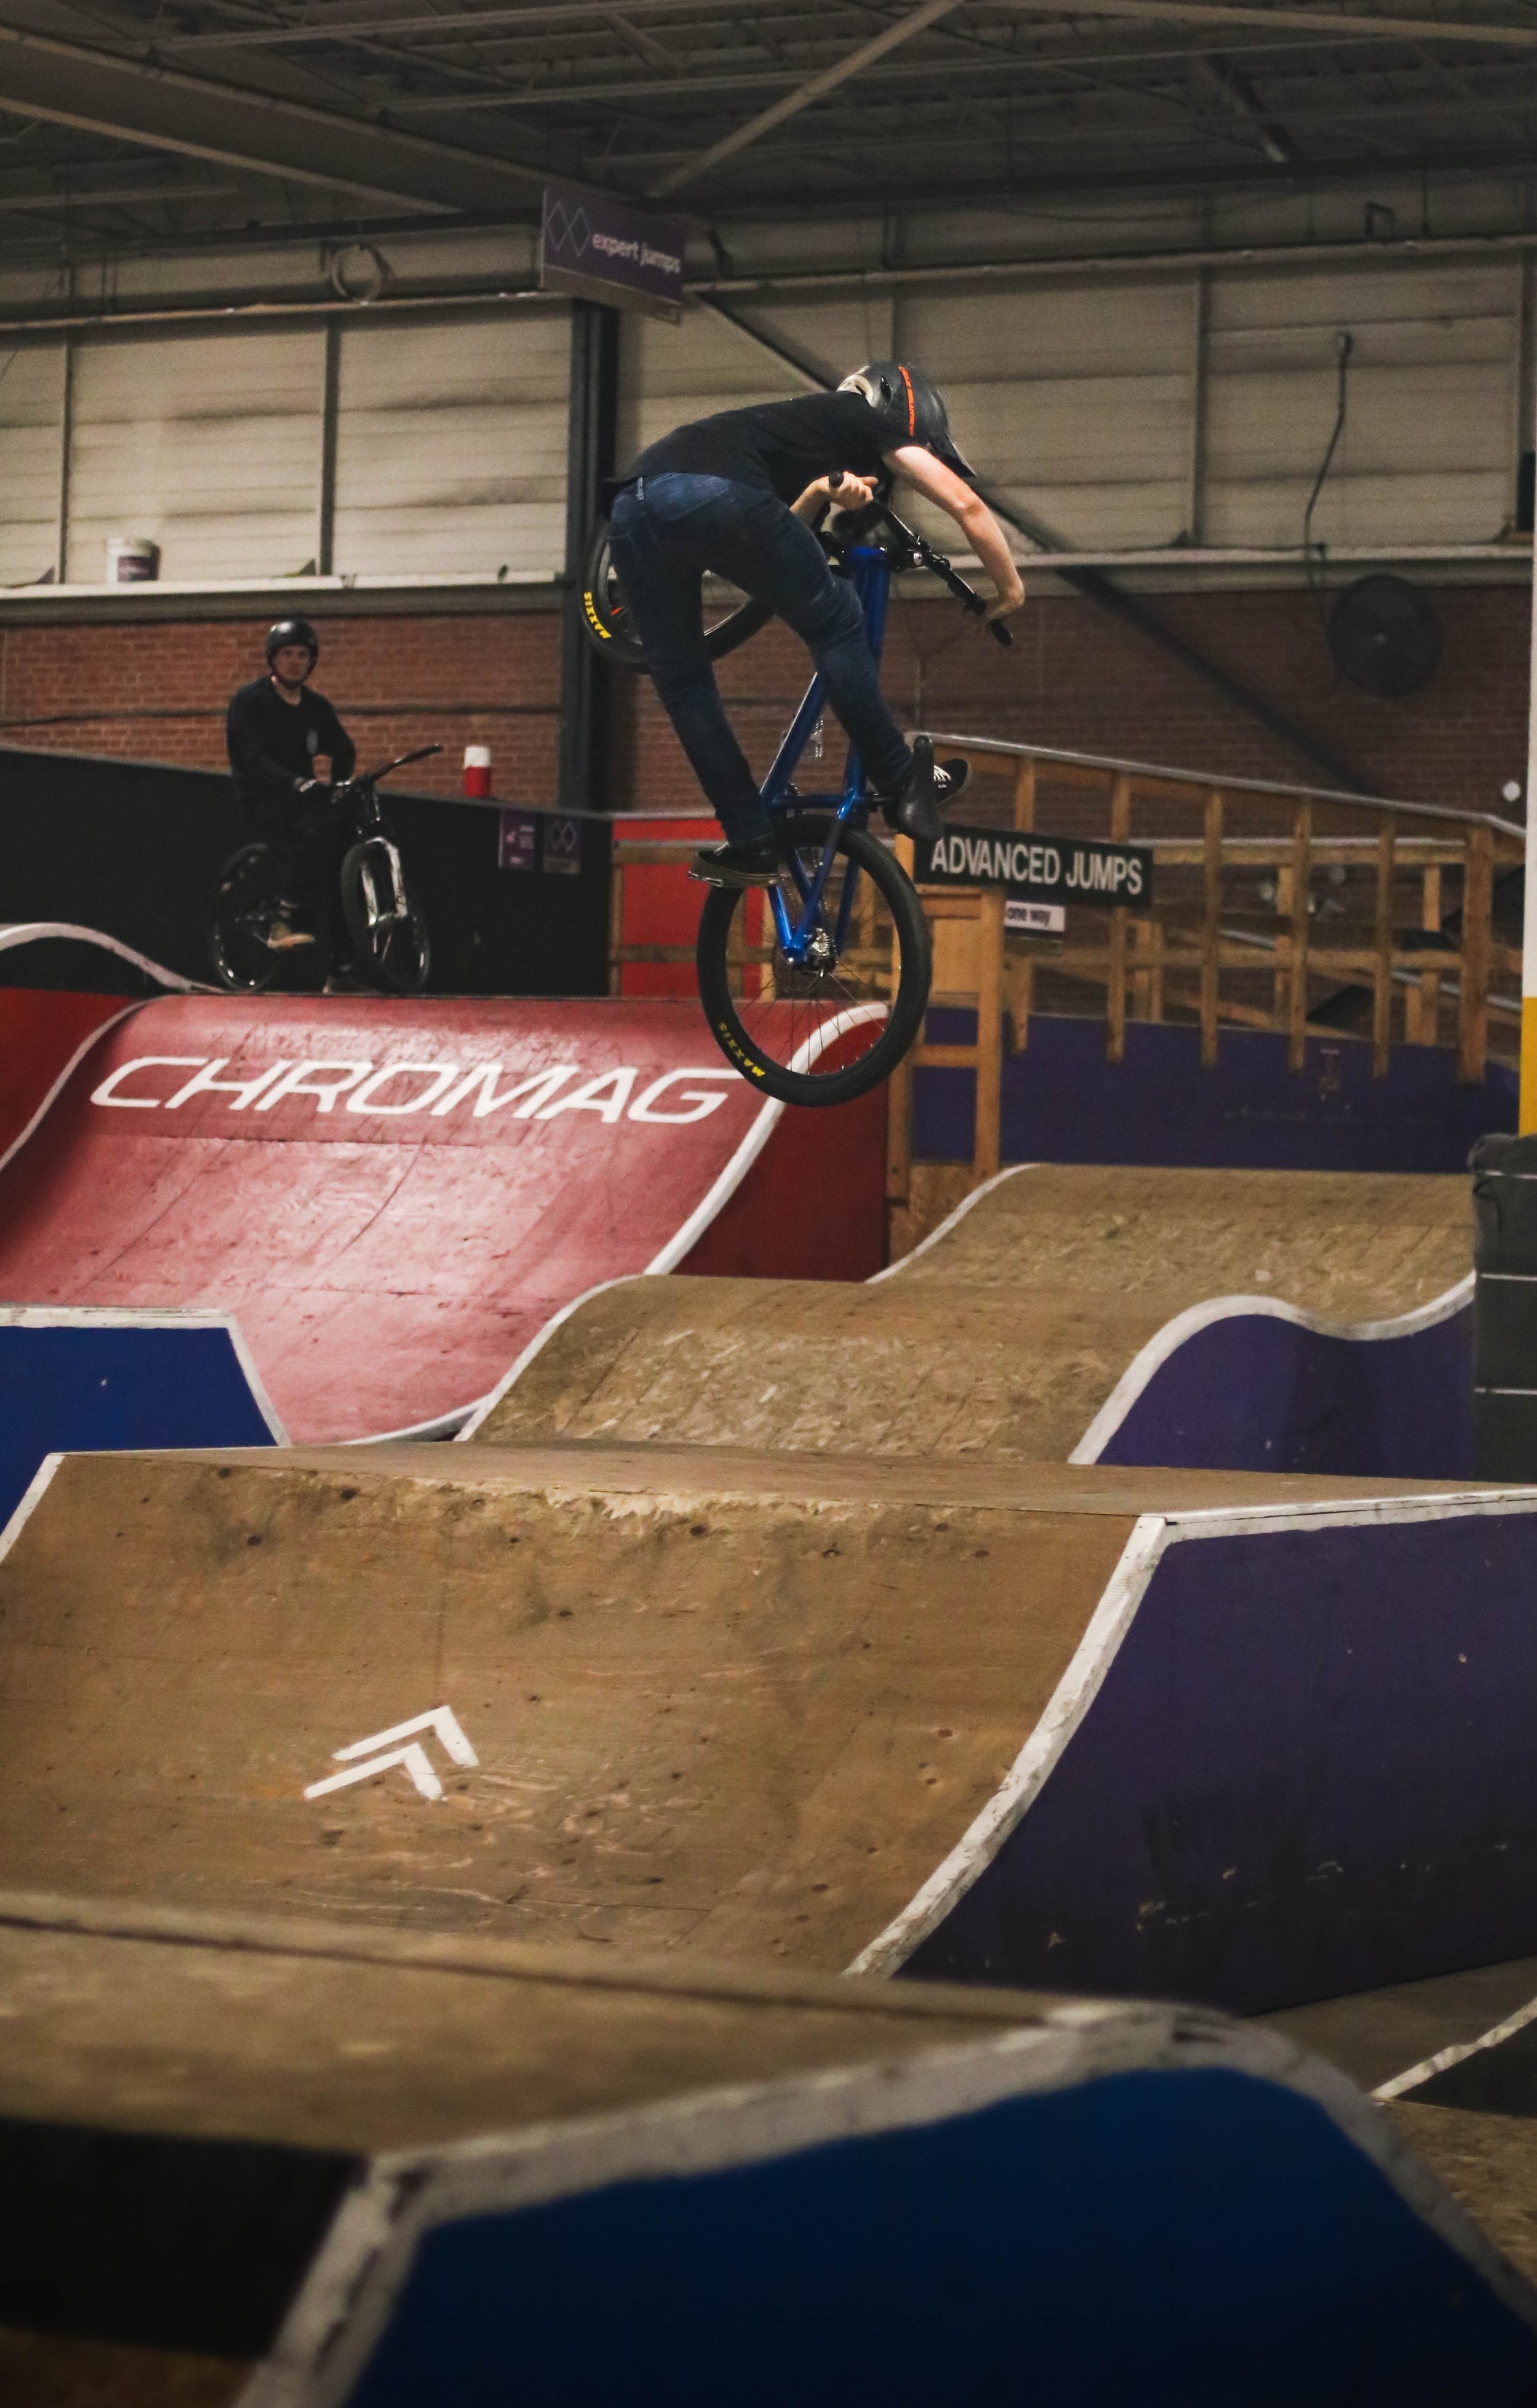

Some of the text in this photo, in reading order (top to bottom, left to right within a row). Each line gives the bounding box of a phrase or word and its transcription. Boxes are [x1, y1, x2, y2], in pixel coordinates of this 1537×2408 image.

[593, 234, 681, 273] expert jumps
[584, 591, 612, 639] MAXXIS
[931, 836, 1144, 894] ADVANCED JUMPS
[1008, 907, 1051, 926] one way
[719, 1022, 765, 1077] MAXXIS
[90, 1057, 745, 1123] CHROMAG
